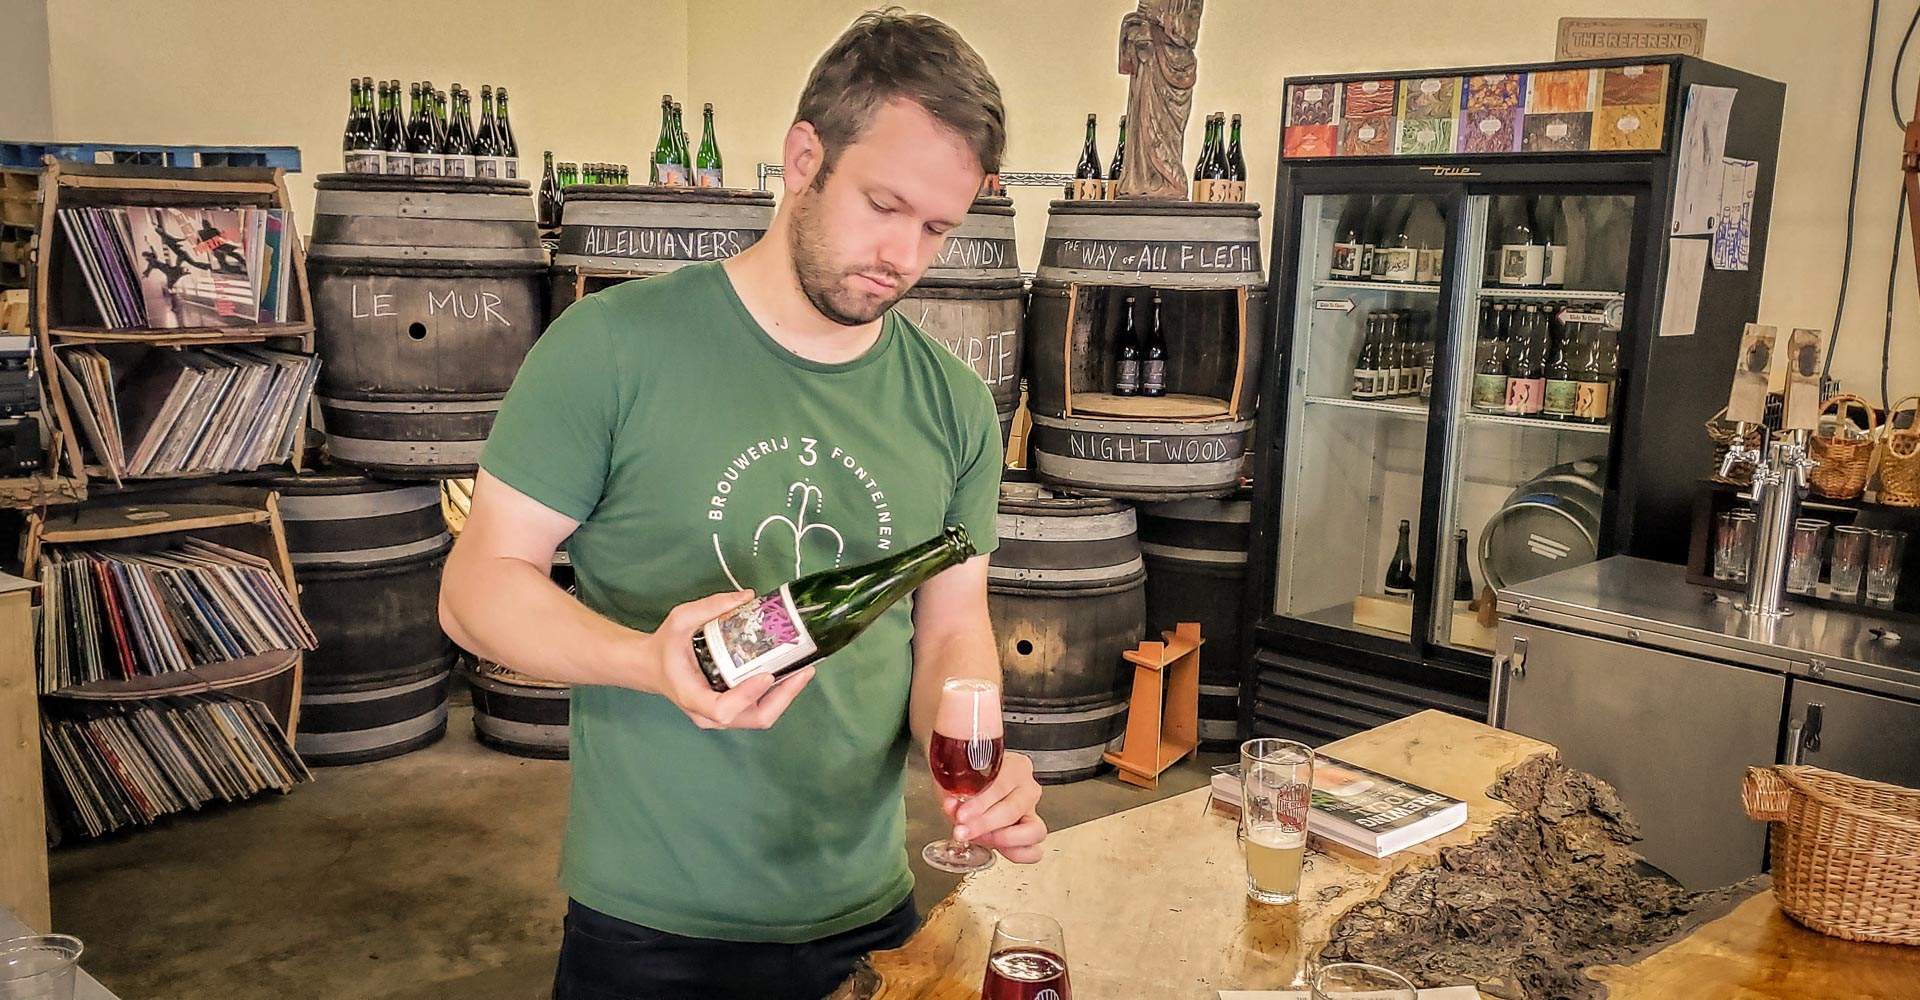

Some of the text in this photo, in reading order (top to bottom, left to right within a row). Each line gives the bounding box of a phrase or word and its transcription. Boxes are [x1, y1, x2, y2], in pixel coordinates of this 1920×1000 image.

[1572, 32, 1692, 49] THE REFEREND
[1419, 165, 1481, 176] true
[1082, 241, 1118, 271] WAY
[1138, 245, 1168, 274] ALL
[1181, 245, 1251, 271] FLESH
[352, 284, 511, 327] LE MUR
[708, 436, 892, 551] BROUWERIJ 3 FONTEINEN
[1349, 791, 1416, 815] LOCAL
[1355, 793, 1449, 828] BREWING
